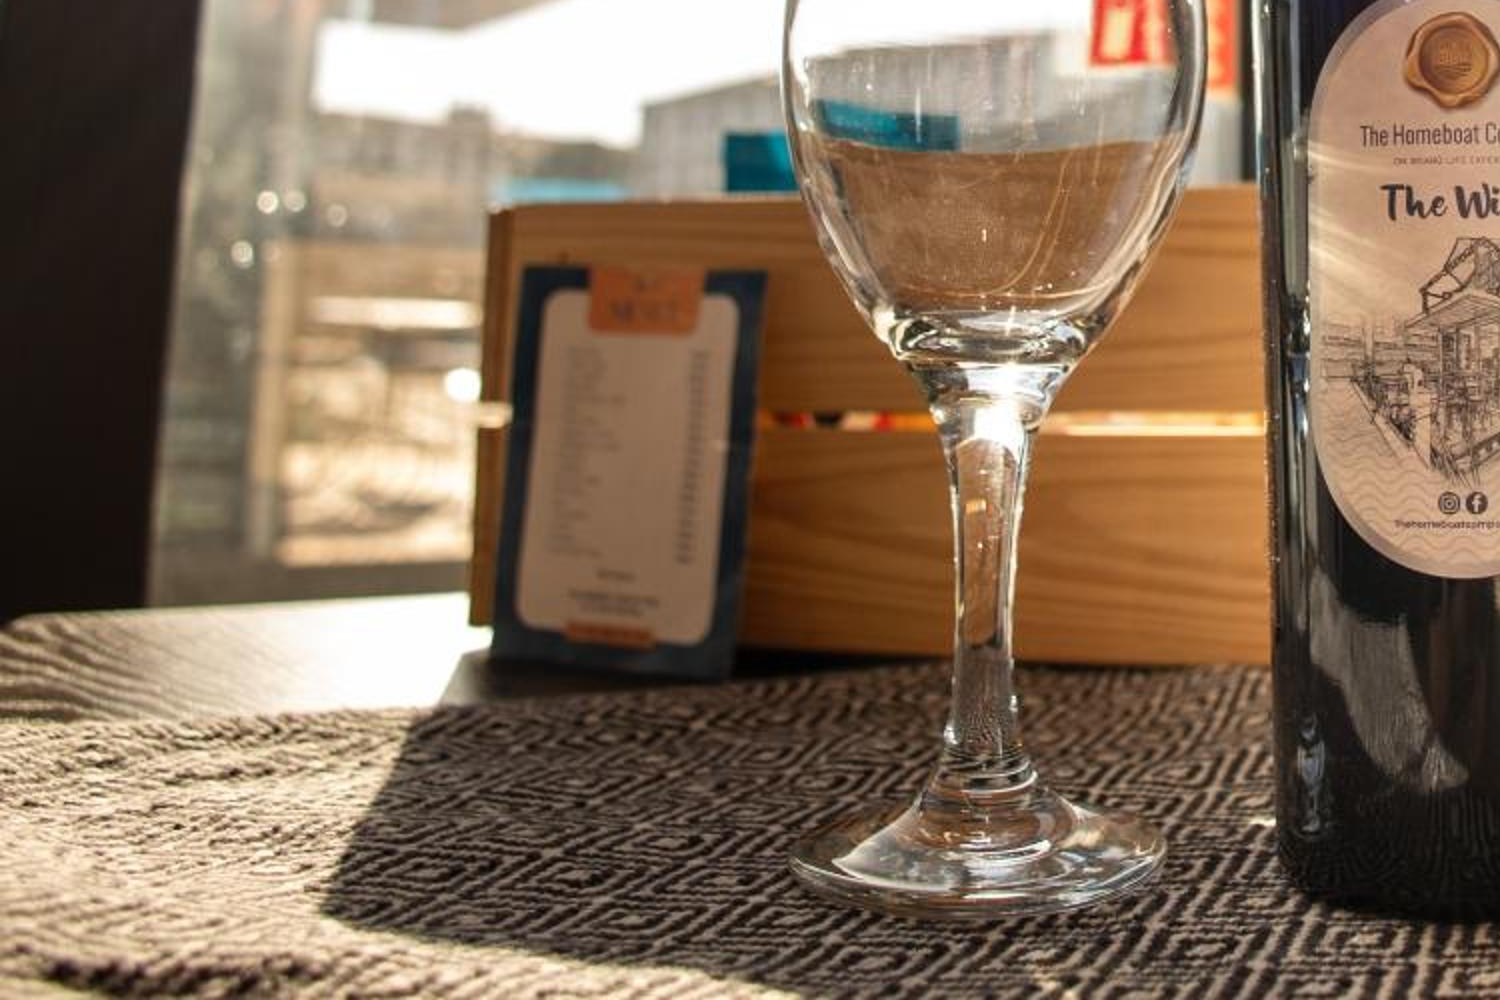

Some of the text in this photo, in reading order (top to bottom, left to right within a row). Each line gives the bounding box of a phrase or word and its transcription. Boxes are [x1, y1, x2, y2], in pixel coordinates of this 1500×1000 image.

[1360, 124, 1389, 147] The
[1393, 123, 1480, 146] Homeboat
[1379, 183, 1449, 221] The
